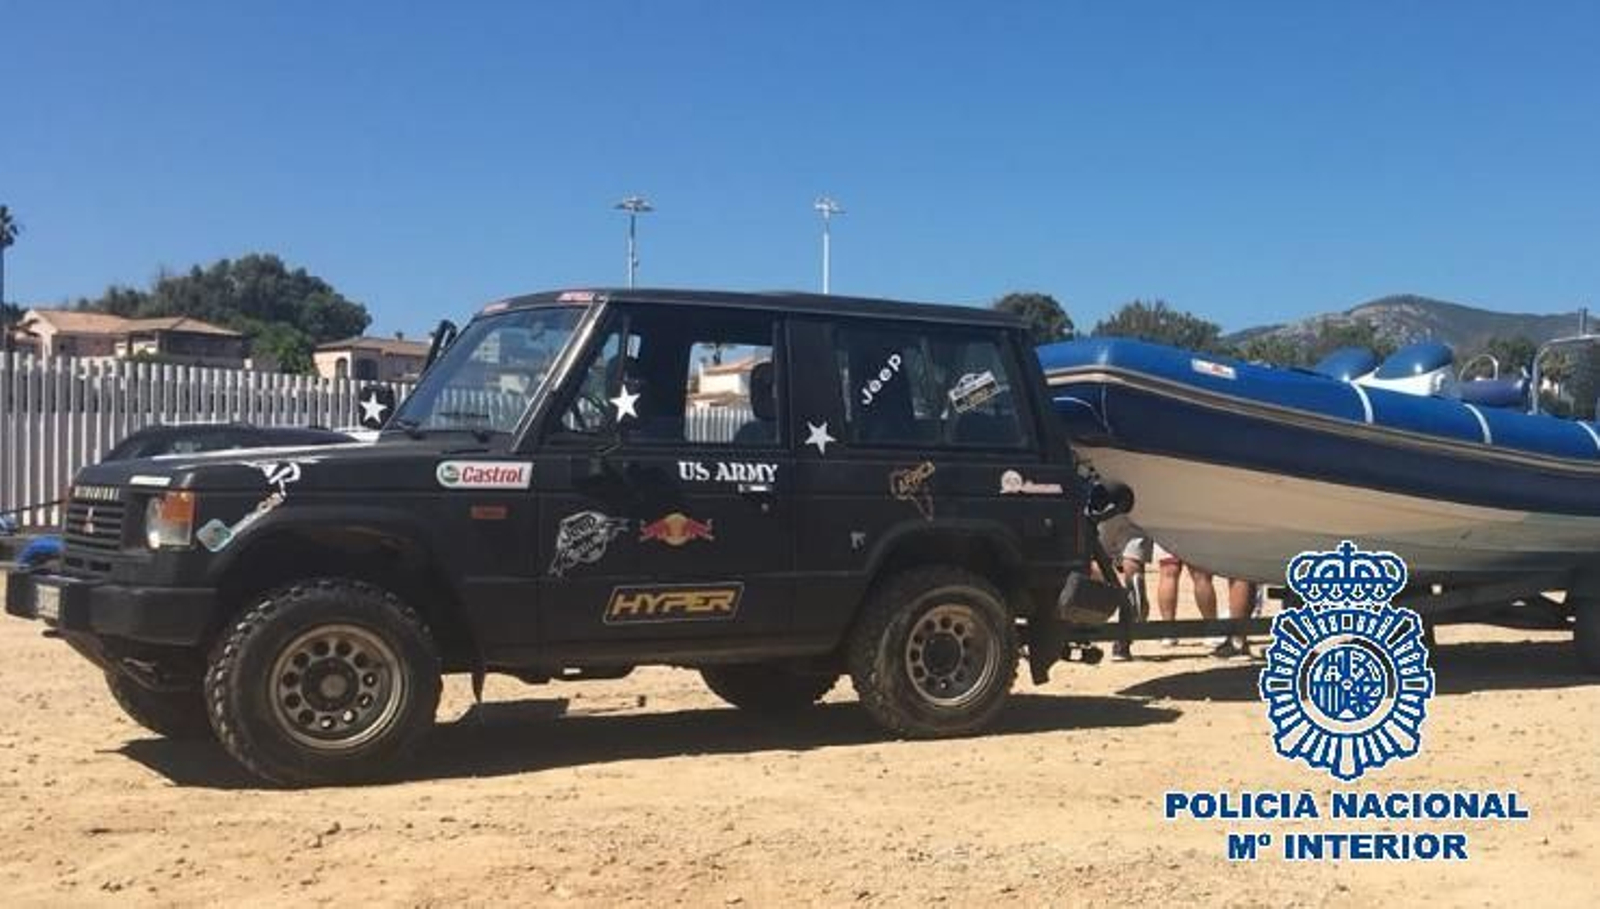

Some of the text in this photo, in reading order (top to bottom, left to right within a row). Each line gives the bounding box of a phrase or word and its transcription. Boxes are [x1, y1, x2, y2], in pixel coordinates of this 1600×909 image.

[861, 353, 902, 405] Jeep
[462, 466, 525, 483] Castrol
[678, 461, 779, 482] US ARMY
[611, 590, 736, 615] HYPER
